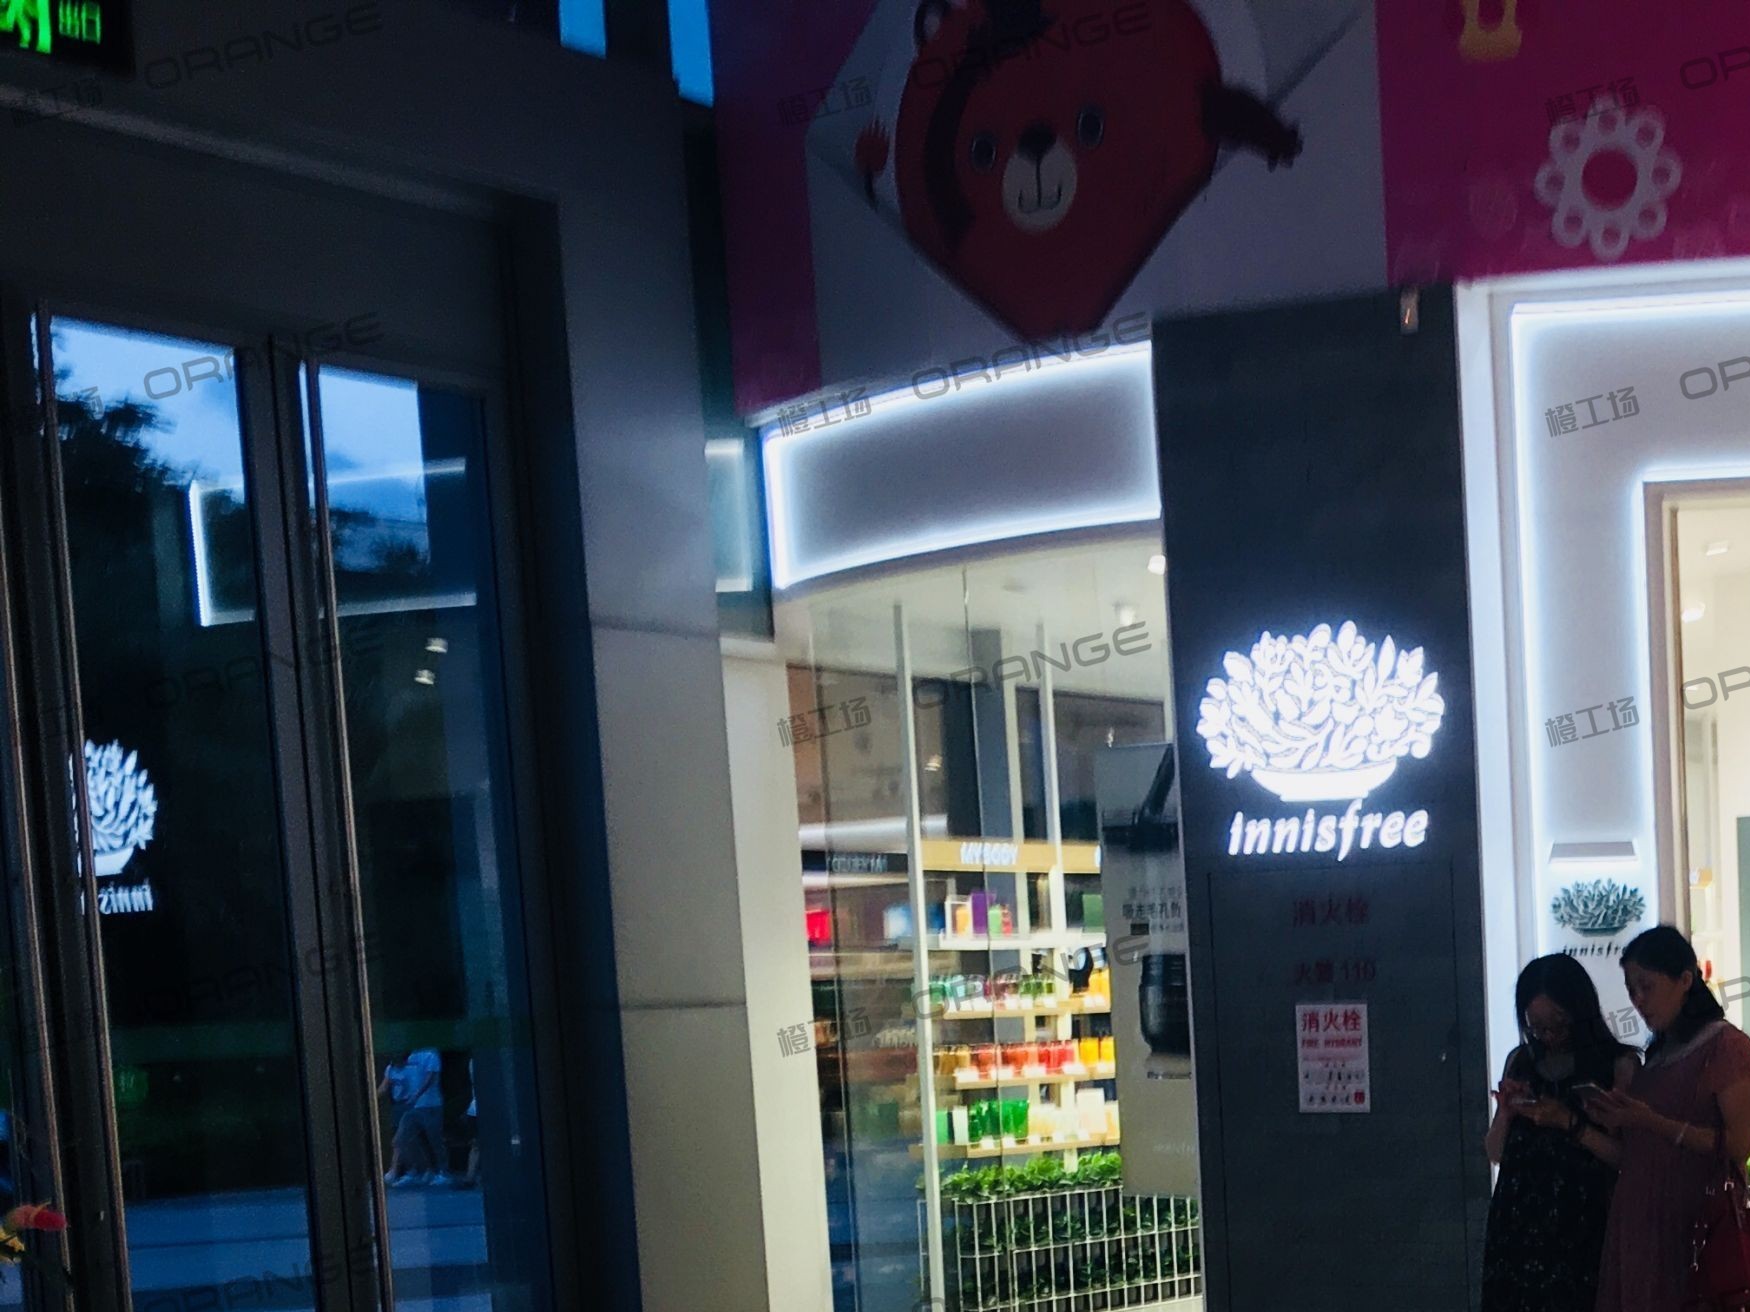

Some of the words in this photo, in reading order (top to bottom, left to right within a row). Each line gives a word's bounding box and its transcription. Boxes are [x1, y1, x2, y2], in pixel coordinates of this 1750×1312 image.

[1228, 799, 1429, 862] innisfree
[1302, 1008, 1362, 1033] 消火栓
